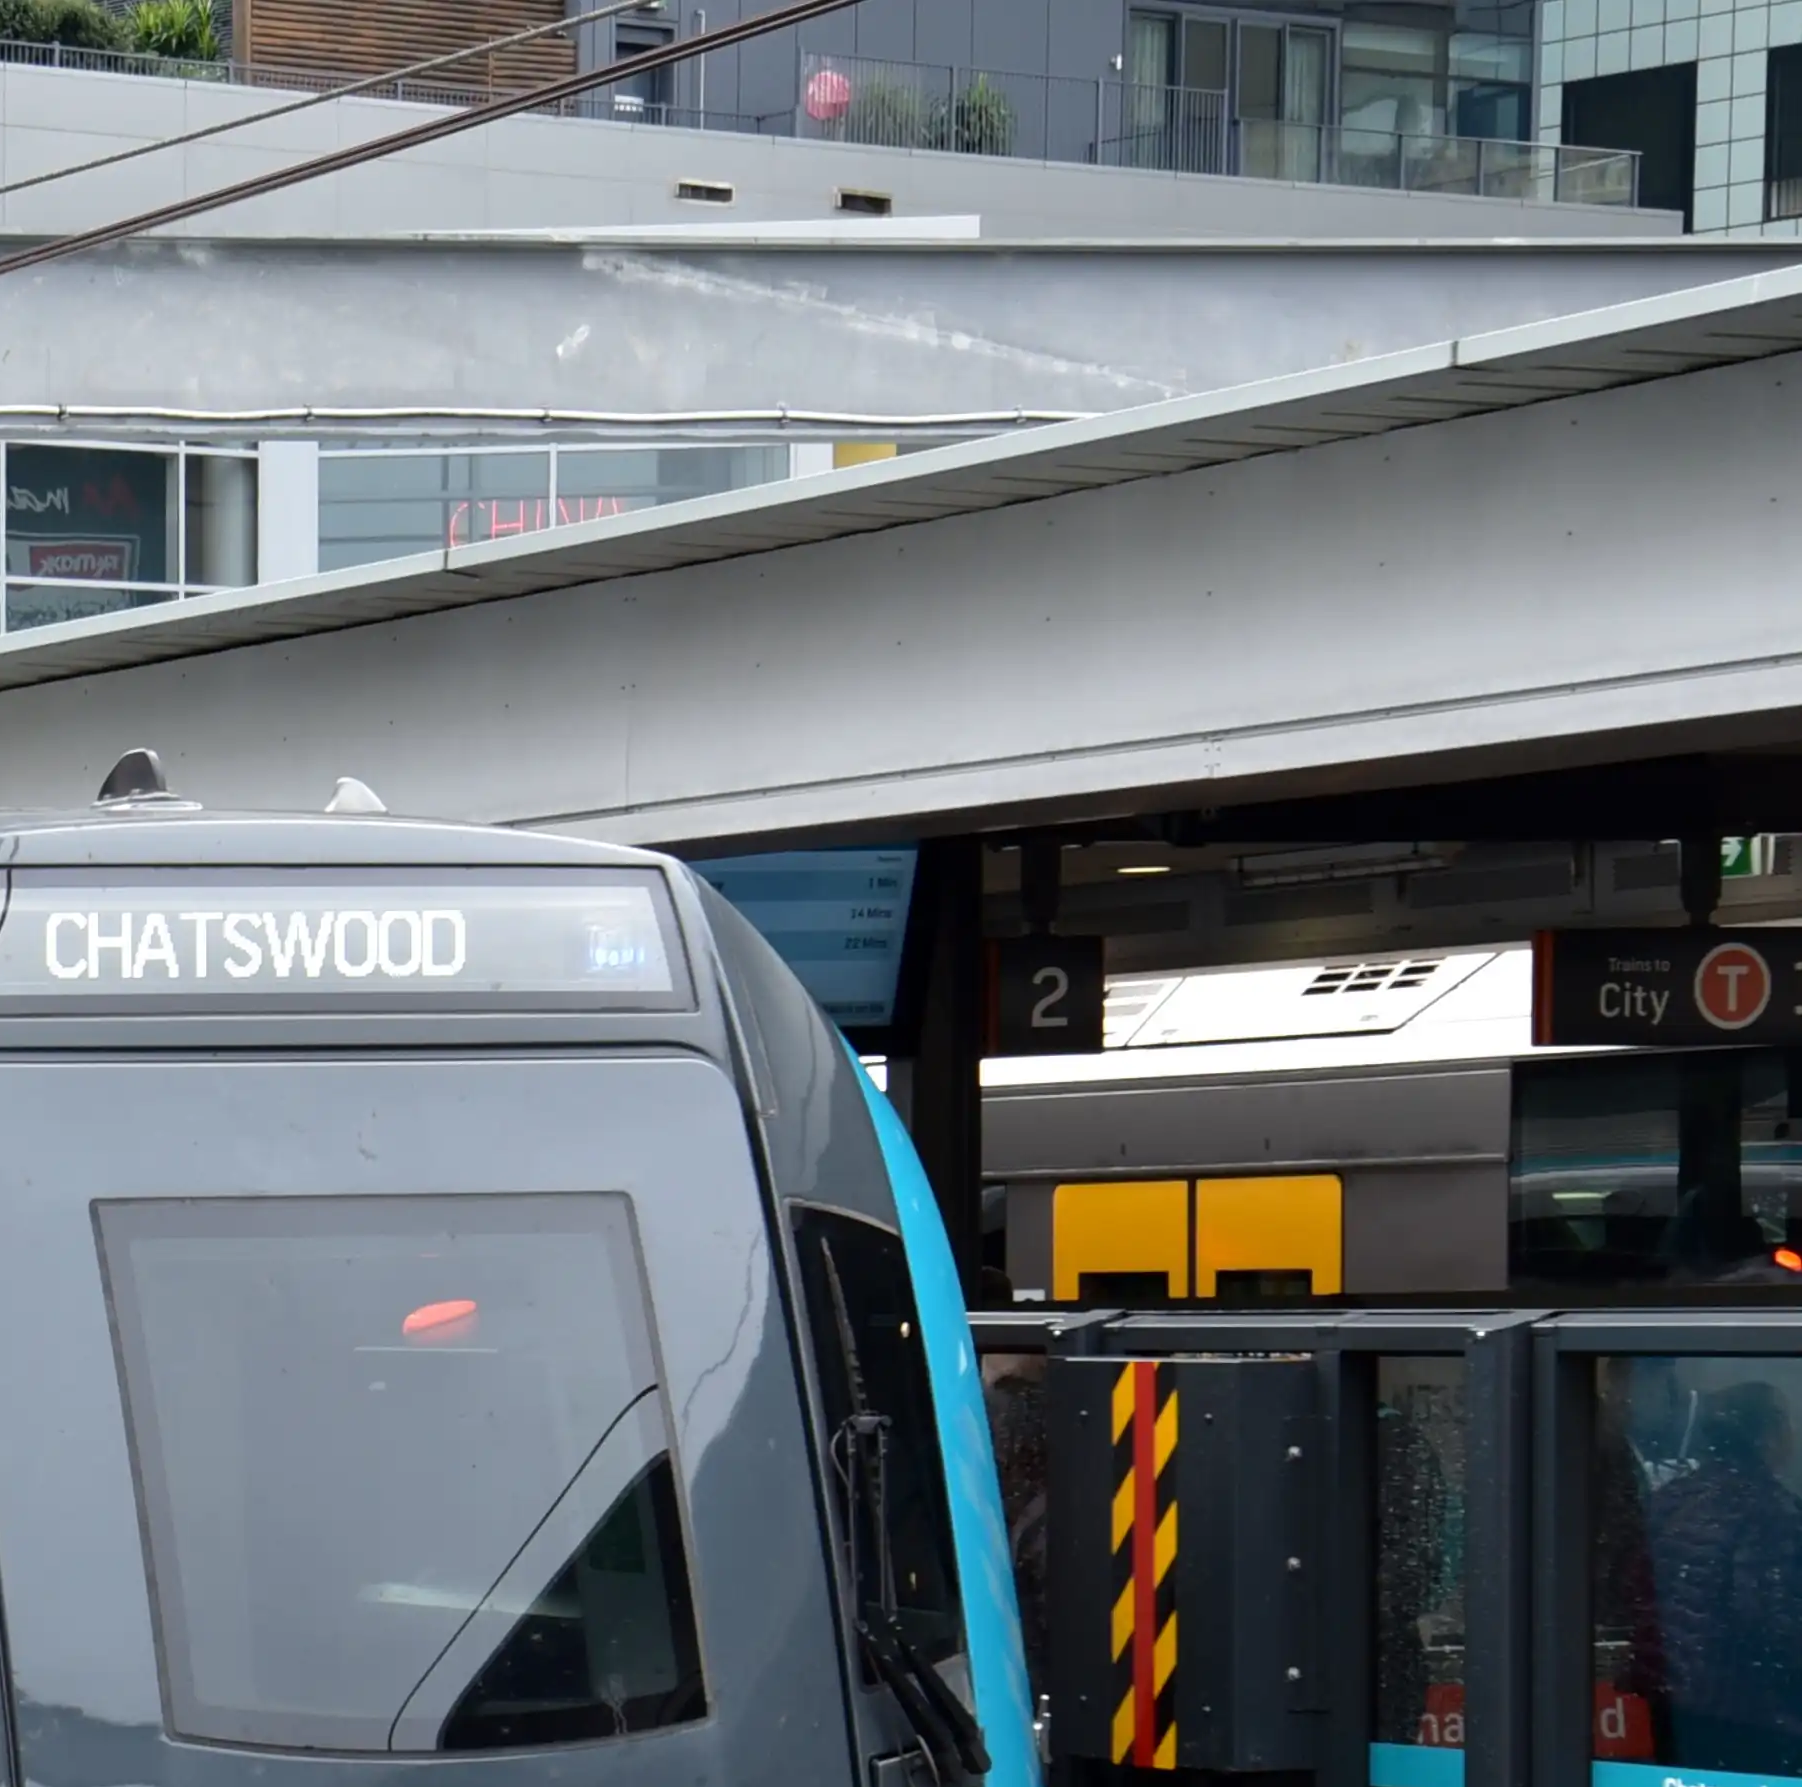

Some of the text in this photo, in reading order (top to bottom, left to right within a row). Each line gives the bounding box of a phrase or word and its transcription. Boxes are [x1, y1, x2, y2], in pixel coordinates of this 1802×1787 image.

[45, 909, 466, 980] CHATSWOOD
[1608, 957, 1670, 973] Trains to
[1031, 966, 1069, 1028] 2
[1599, 981, 1670, 1026] City
[1716, 965, 1749, 1011] T
